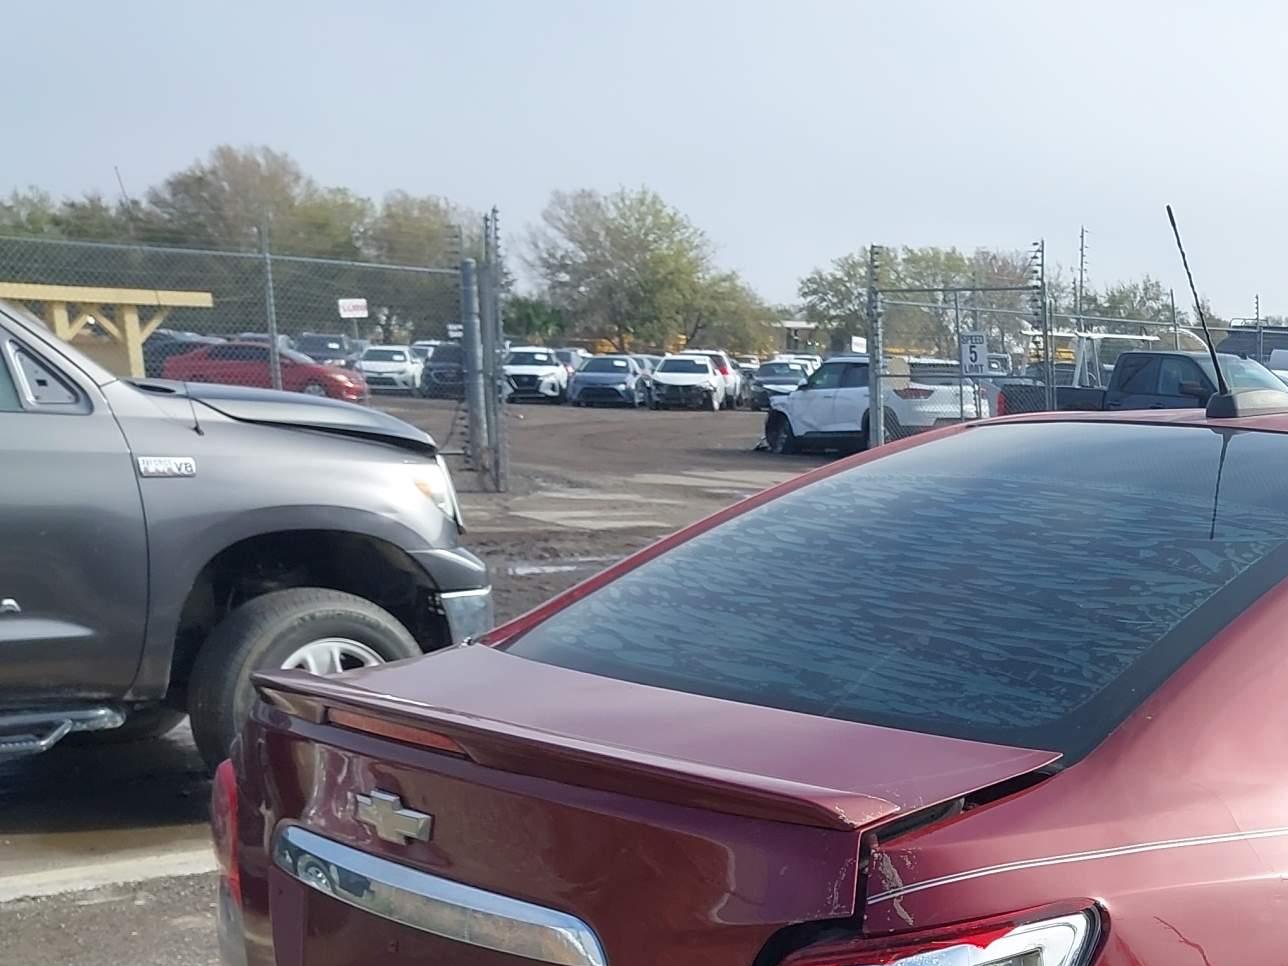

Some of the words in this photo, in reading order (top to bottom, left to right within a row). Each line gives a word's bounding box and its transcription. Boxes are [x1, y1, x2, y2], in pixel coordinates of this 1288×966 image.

[961, 335, 984, 344] SPEED
[969, 345, 977, 363] 5
[964, 363, 984, 373] LIMIT
[174, 462, 193, 473] V8
